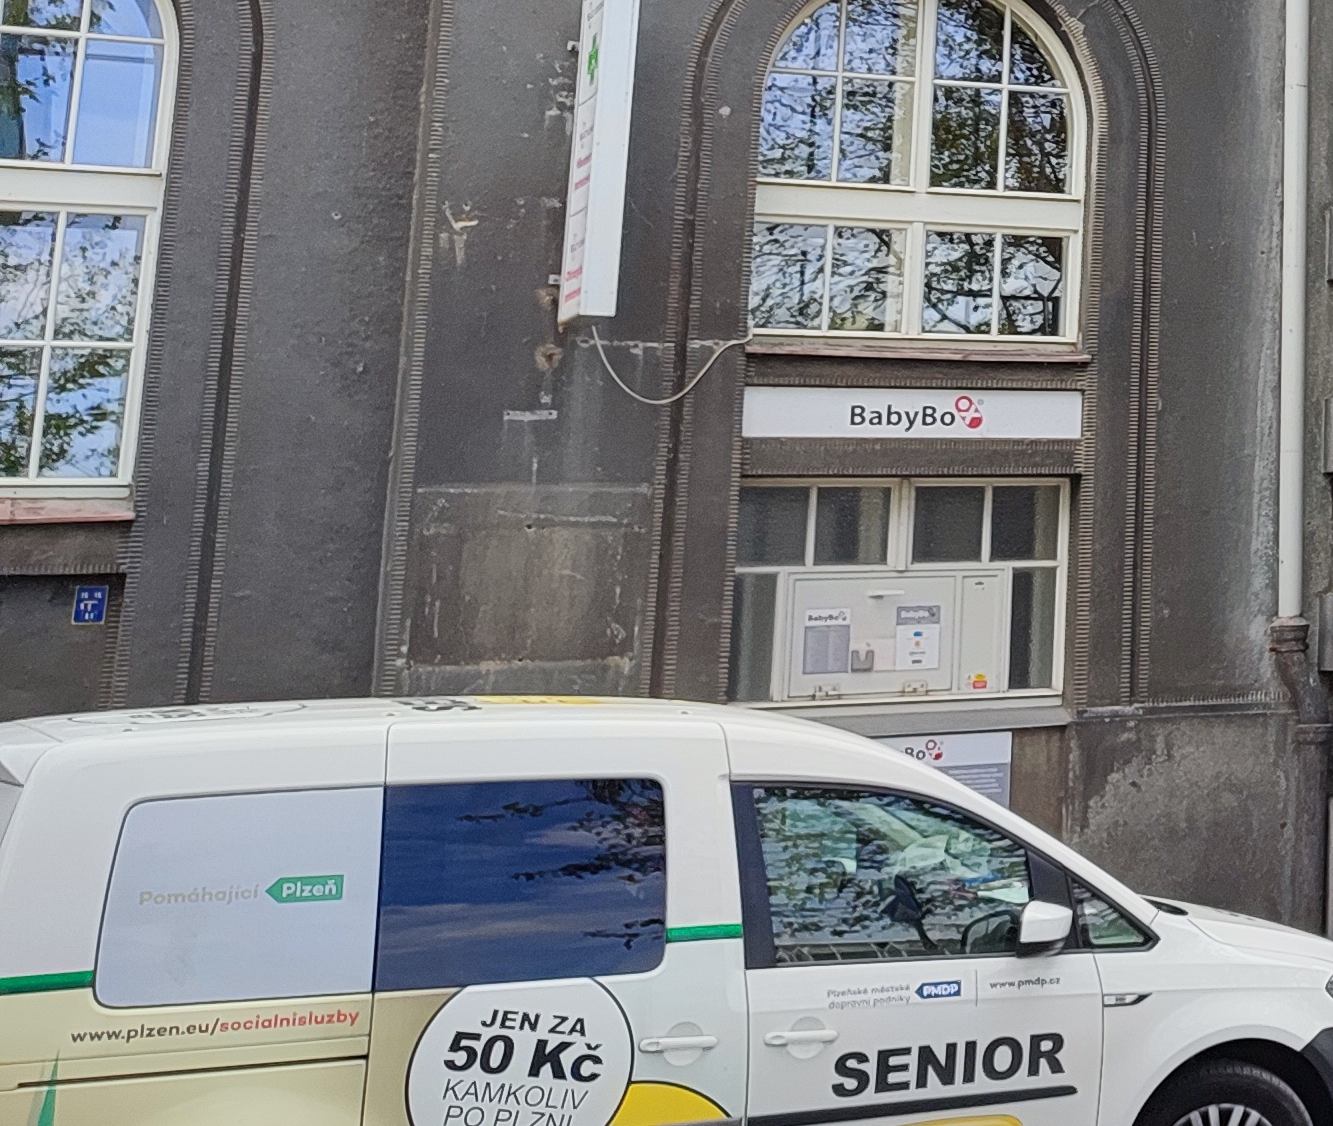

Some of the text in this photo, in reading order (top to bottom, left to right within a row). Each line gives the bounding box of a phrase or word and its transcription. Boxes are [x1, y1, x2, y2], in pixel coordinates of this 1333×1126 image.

[138, 879, 337, 906] Pomáhající Plzeň
[922, 976, 1061, 998] PMDP www.pmdp.cz
[70, 1009, 360, 1044] www.plzen.eu/socialnisluzby
[480, 1009, 587, 1037] JEN ZA
[443, 1031, 604, 1083] 50 Kč
[831, 1032, 1066, 1098] SENIOR
[442, 1078, 589, 1110] KAMKOLIV
[443, 1105, 485, 1126] PO
